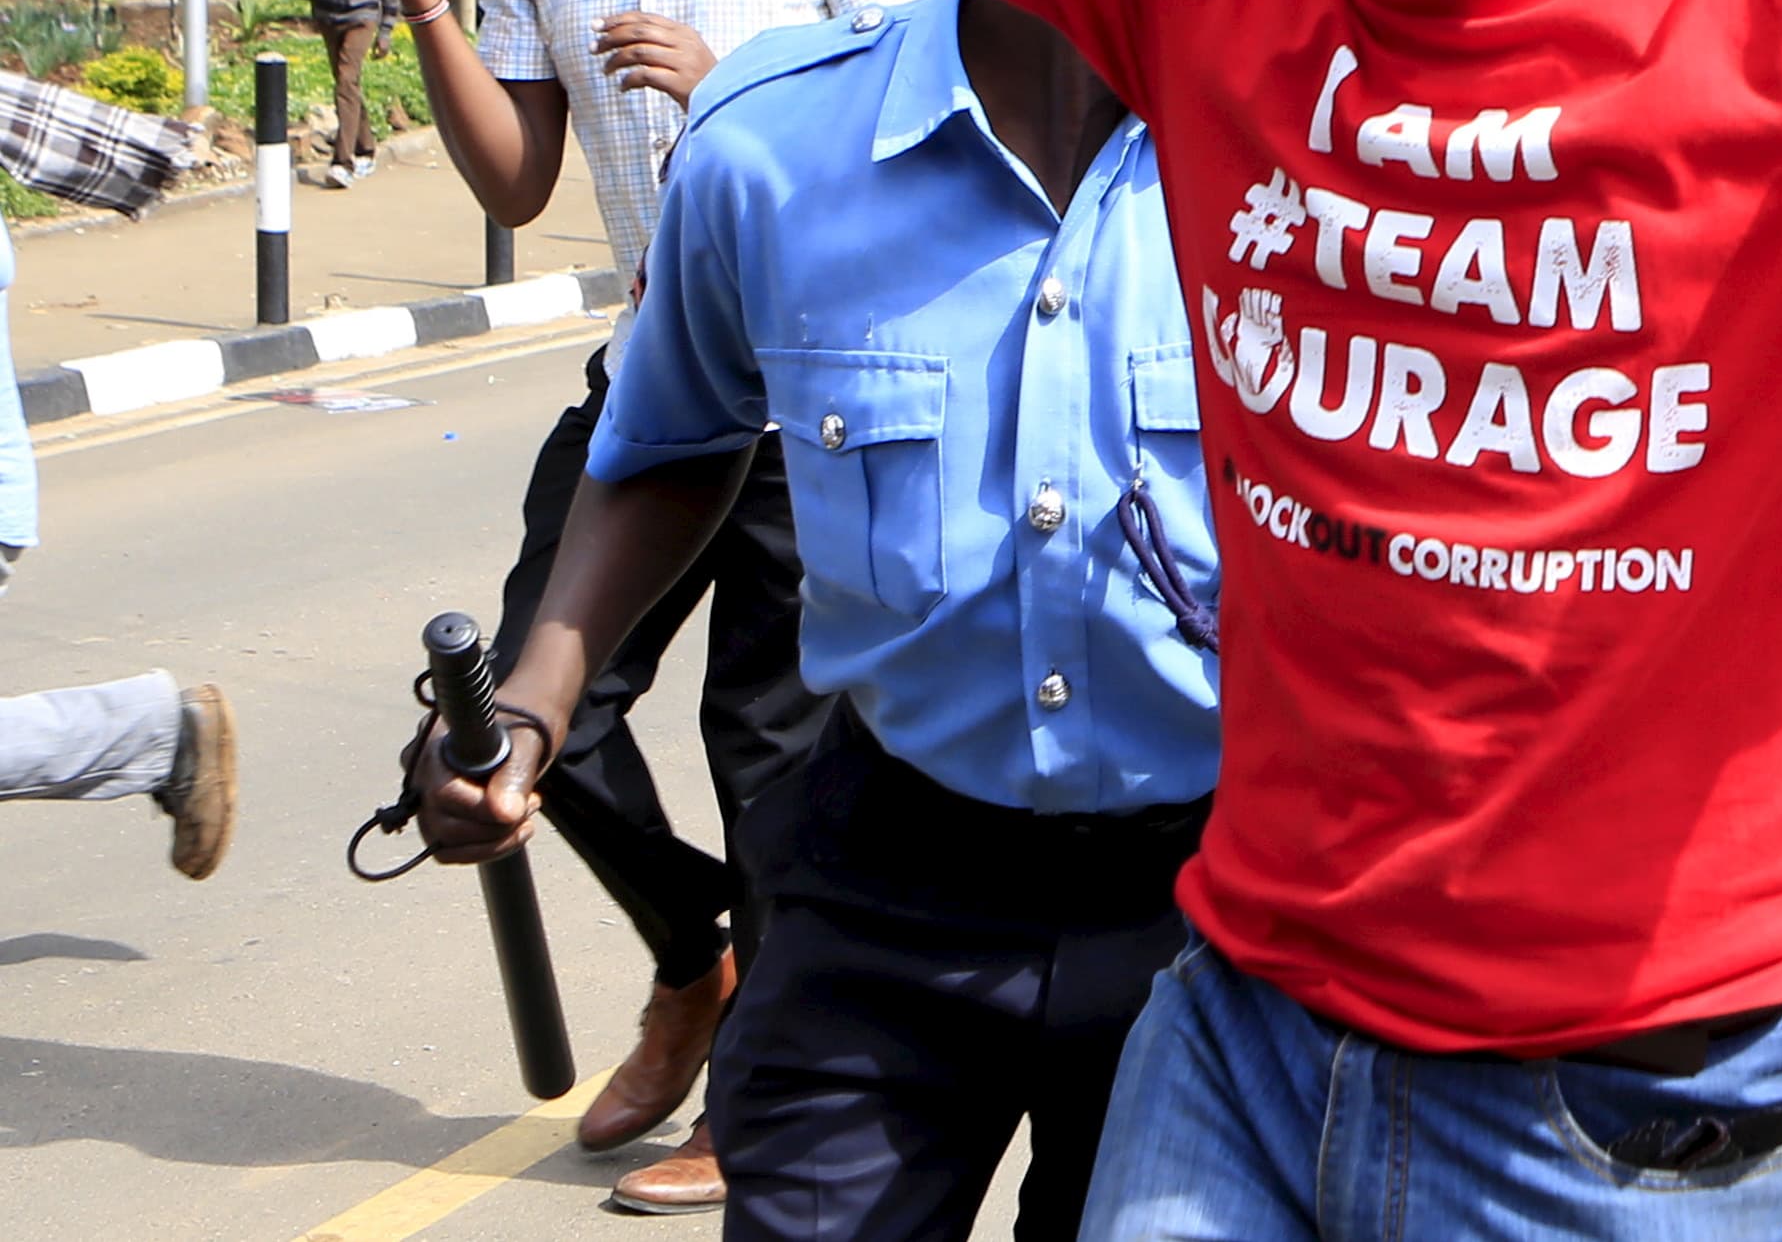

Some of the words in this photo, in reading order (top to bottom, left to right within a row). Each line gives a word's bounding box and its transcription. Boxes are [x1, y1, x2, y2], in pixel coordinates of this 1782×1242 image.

[1307, 44, 1359, 154] I
[1356, 103, 1562, 182] AM
[1227, 166, 1643, 332] #TEAM
